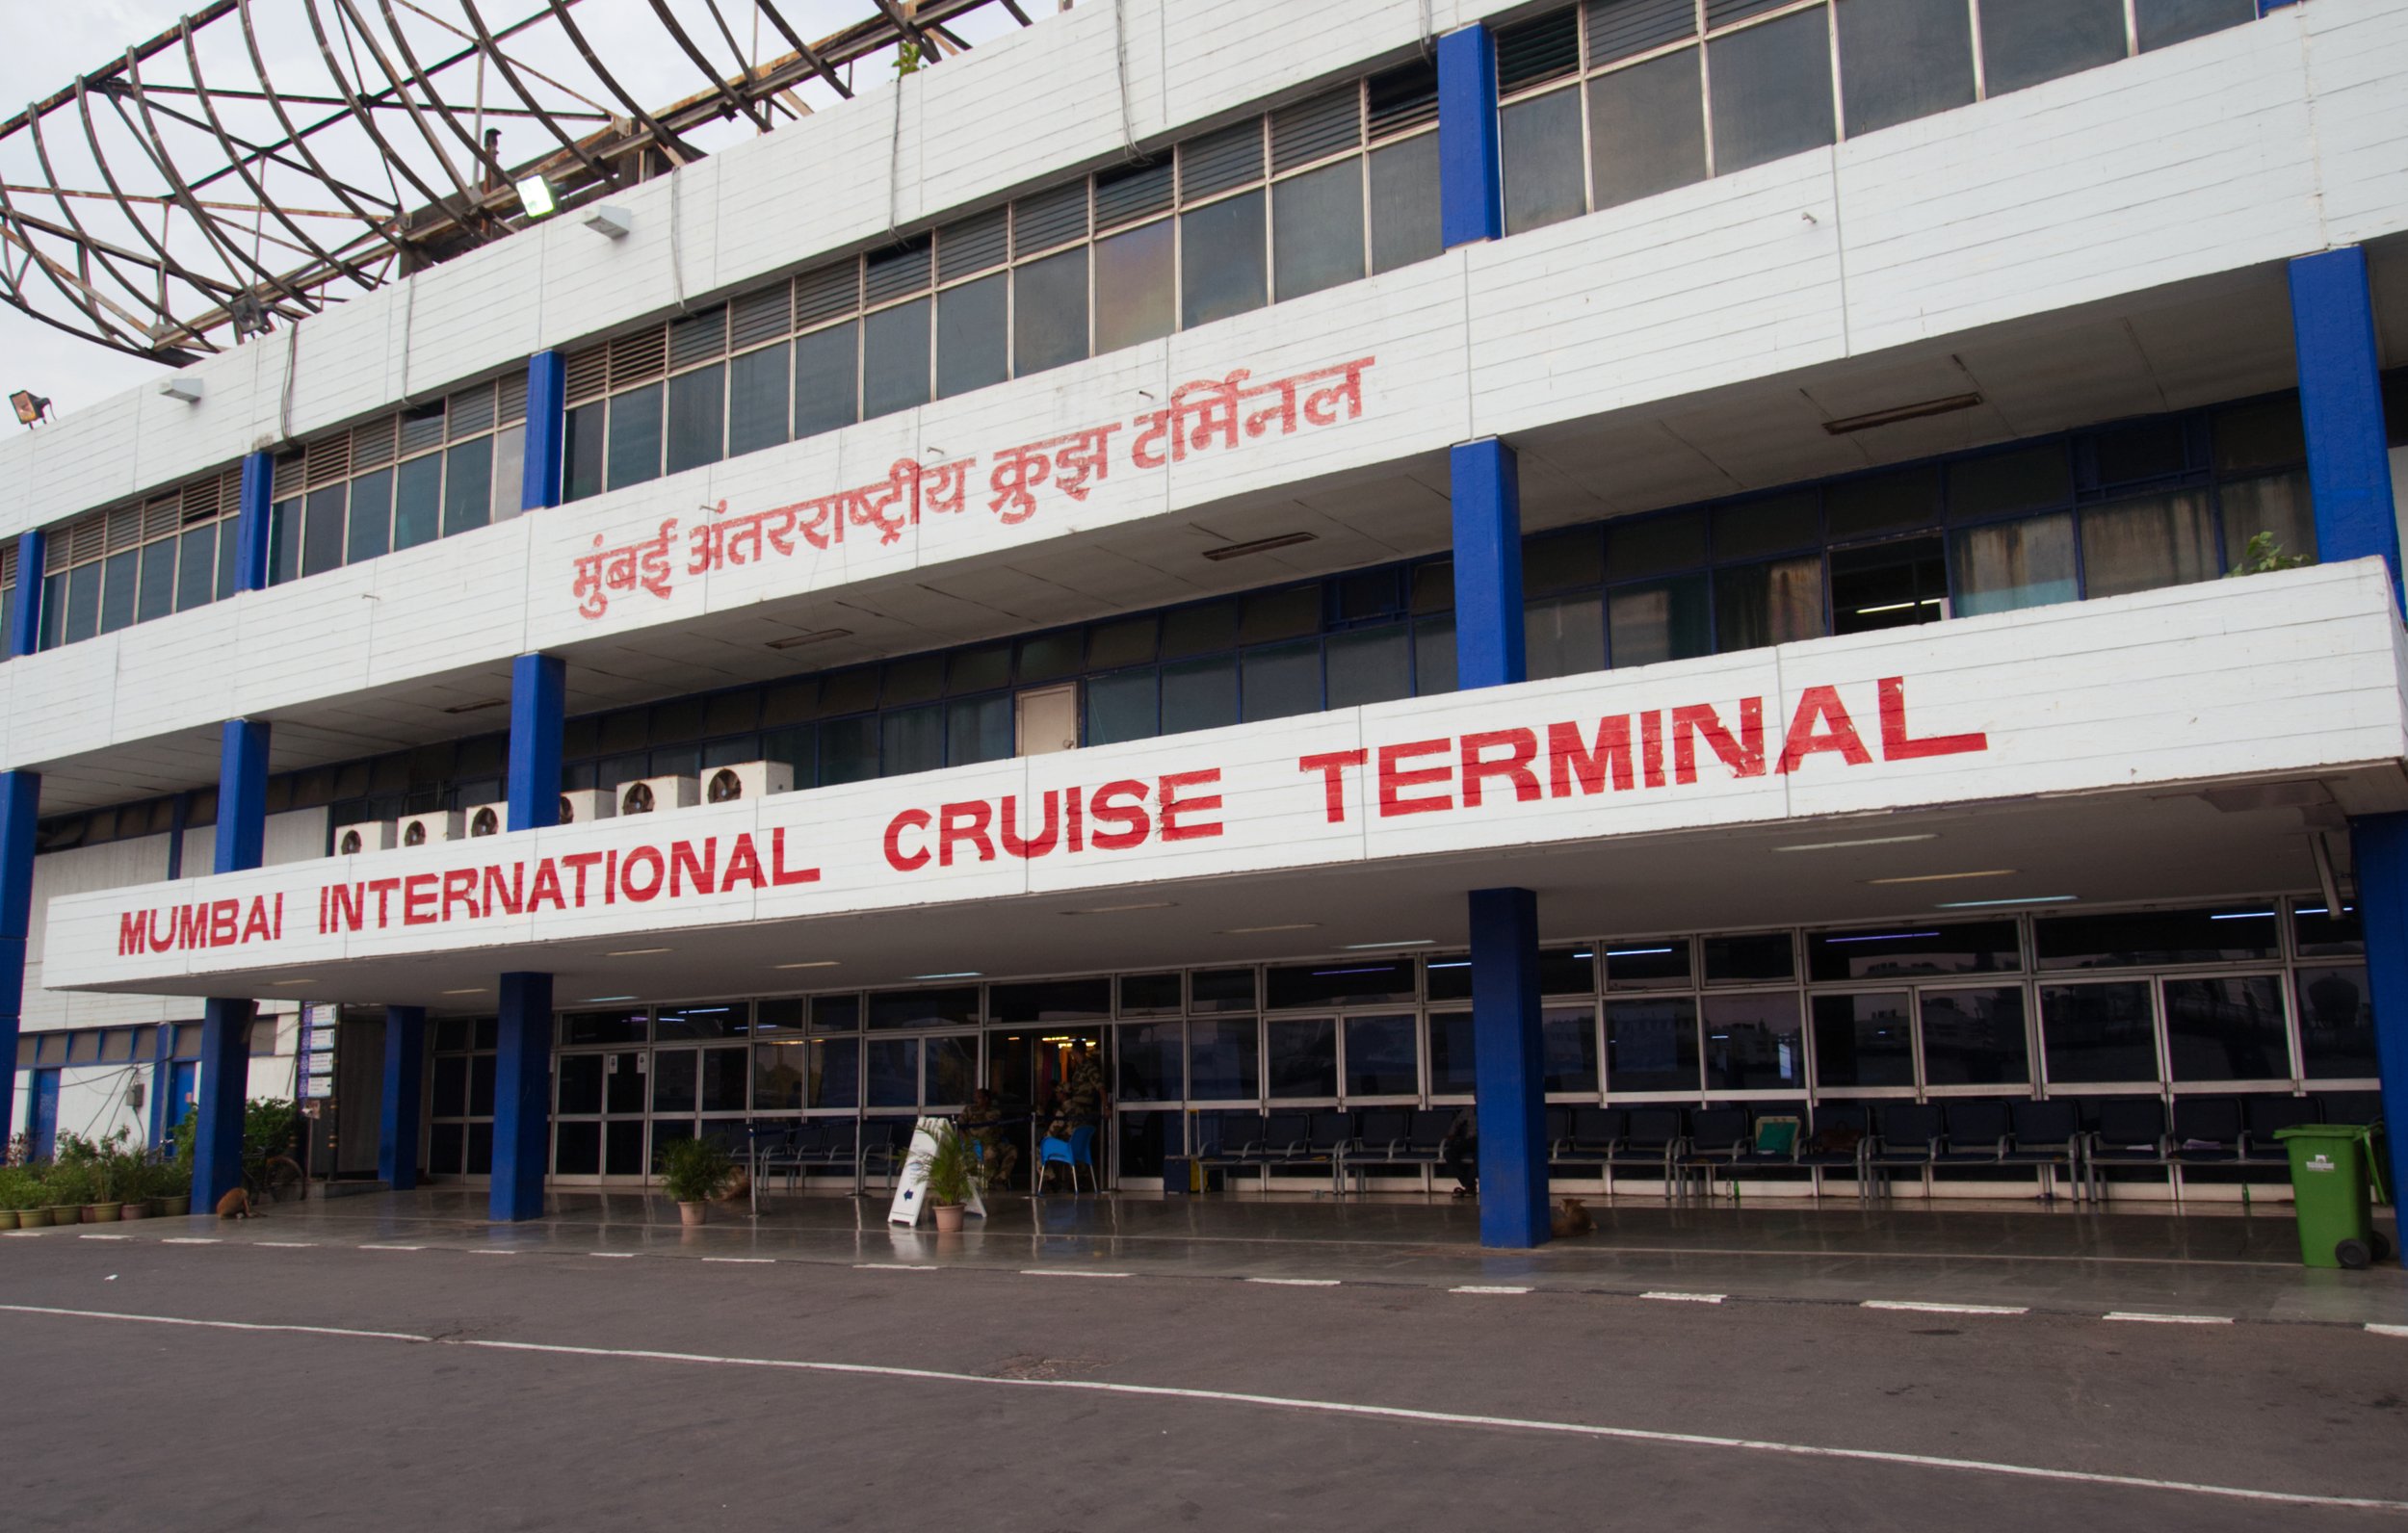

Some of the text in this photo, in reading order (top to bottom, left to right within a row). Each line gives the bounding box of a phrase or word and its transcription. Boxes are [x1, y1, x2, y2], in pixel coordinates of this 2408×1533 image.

[573, 518, 678, 619] मुंबई
[687, 457, 976, 576] अंतरराष्ट्रीय
[1132, 355, 1375, 470] टर्मिनल
[118, 676, 1988, 956] MUMBAI INTERNATIONAL CRUISE TERMINAL
